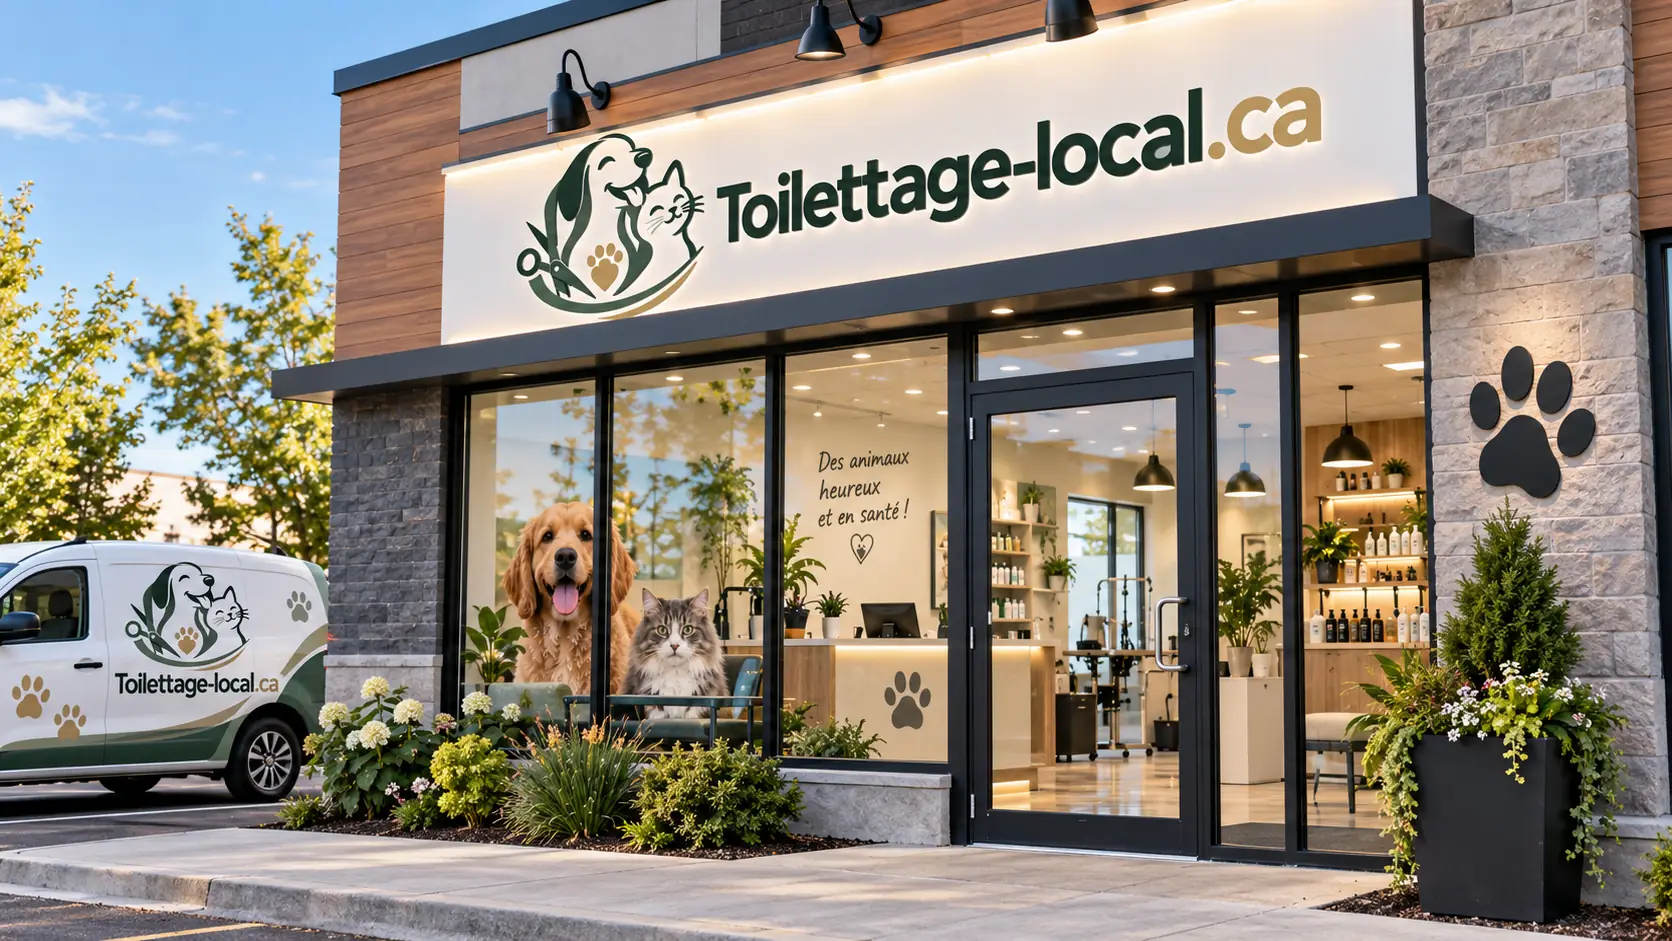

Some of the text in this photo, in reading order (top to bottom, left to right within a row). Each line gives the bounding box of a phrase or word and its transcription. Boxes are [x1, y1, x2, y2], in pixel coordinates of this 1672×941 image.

[716, 86, 1323, 244] Toilettage-local.ca
[818, 450, 910, 473] Des animaux
[819, 479, 881, 500] heureux
[818, 508, 833, 527] et
[838, 512, 854, 525] en
[860, 502, 899, 523] santé
[114, 672, 279, 698] Toilettage-local.ca
